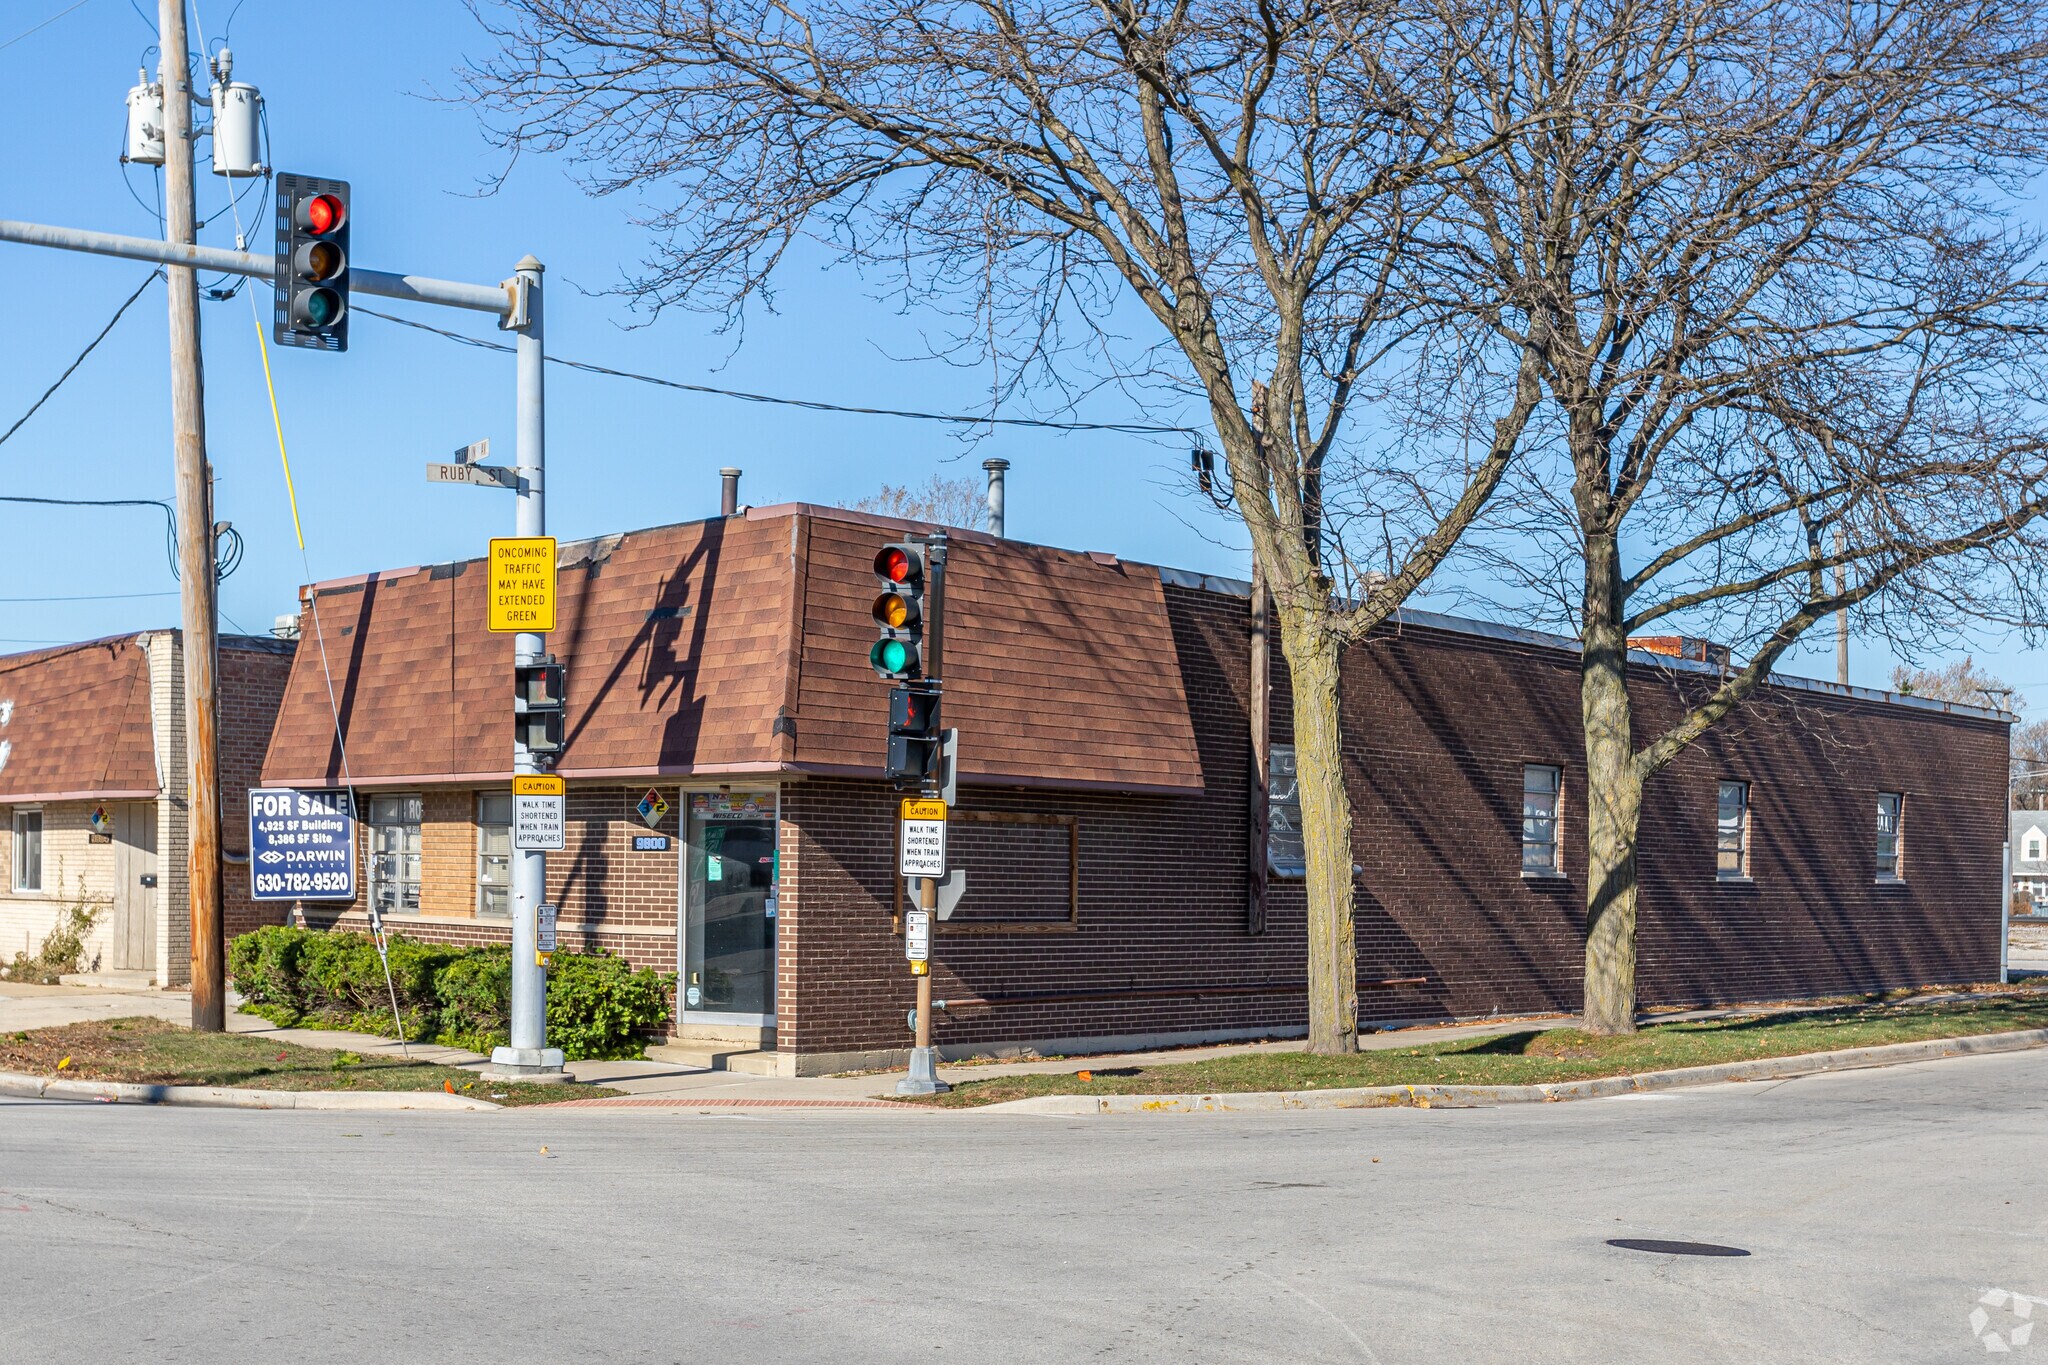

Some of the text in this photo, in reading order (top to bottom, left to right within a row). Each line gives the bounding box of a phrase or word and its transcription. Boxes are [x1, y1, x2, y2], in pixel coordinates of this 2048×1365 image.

[440, 465, 472, 481] RUBY
[498, 547, 547, 558] ONCOMING
[504, 563, 541, 574] TRAFFIC
[498, 579, 545, 590] MAY HAVE
[498, 594, 545, 606] EXTENDED
[507, 611, 537, 621] GREEN
[522, 782, 555, 790] CAUTION
[253, 794, 348, 817] FOR SALE
[522, 801, 556, 809] WALK TIME
[520, 812, 558, 820] SHORTENED
[910, 807, 938, 815] CAUTION
[258, 820, 343, 832] 4,925 SF Building
[520, 823, 559, 831] WHEN TRAIN
[909, 826, 938, 834] WALK TIME
[268, 833, 333, 846] 8,386 SF Site
[518, 834, 561, 842] APPROACHES
[636, 837, 666, 849] 9800
[907, 837, 939, 846] SHORTENED
[286, 850, 345, 862] DARWIN
[906, 848, 940, 857] WHEN TRAIN
[904, 859, 941, 868] APPROACHES
